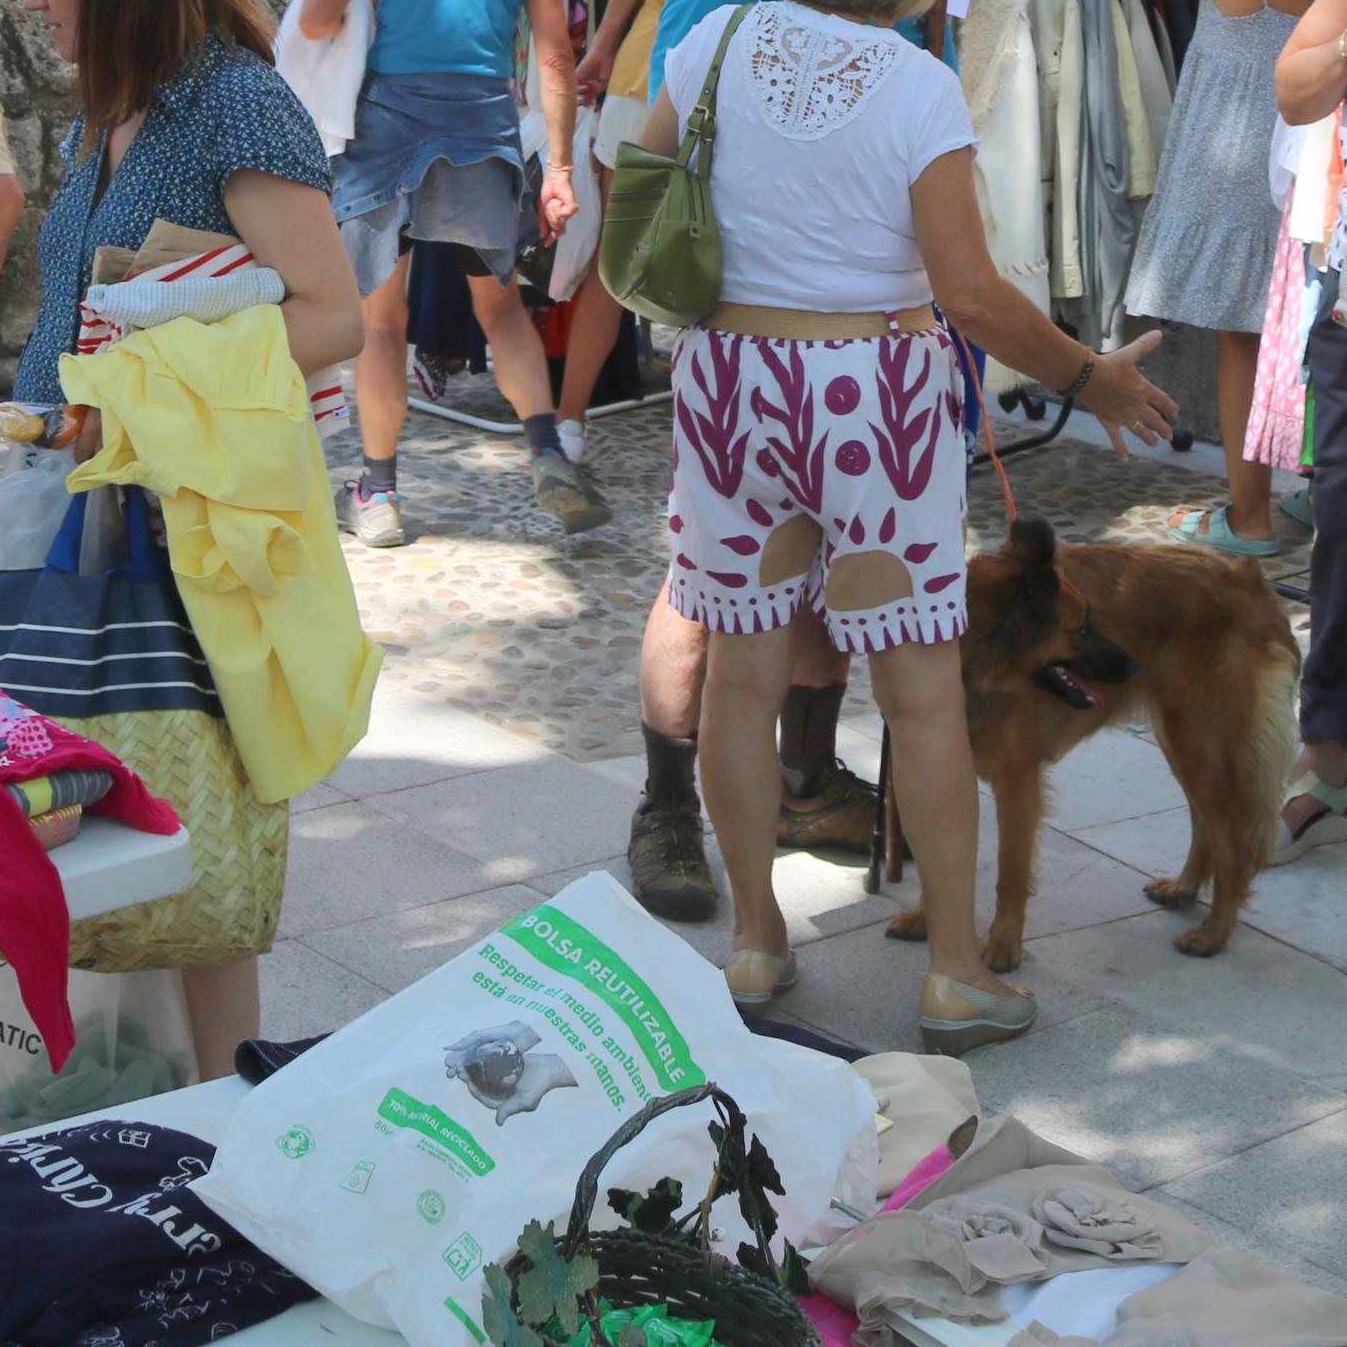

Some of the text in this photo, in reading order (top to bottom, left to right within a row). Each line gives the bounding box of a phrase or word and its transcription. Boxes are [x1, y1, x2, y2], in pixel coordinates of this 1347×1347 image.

[471, 970, 628, 1112] está en nuestras manos.
[477, 943, 546, 996] Respetar
[544, 983, 562, 999] el
[559, 992, 605, 1038] medio
[521, 913, 686, 1085] BOLSA REUTILIZABLE
[439, 1126, 487, 1170] RECICLADO
